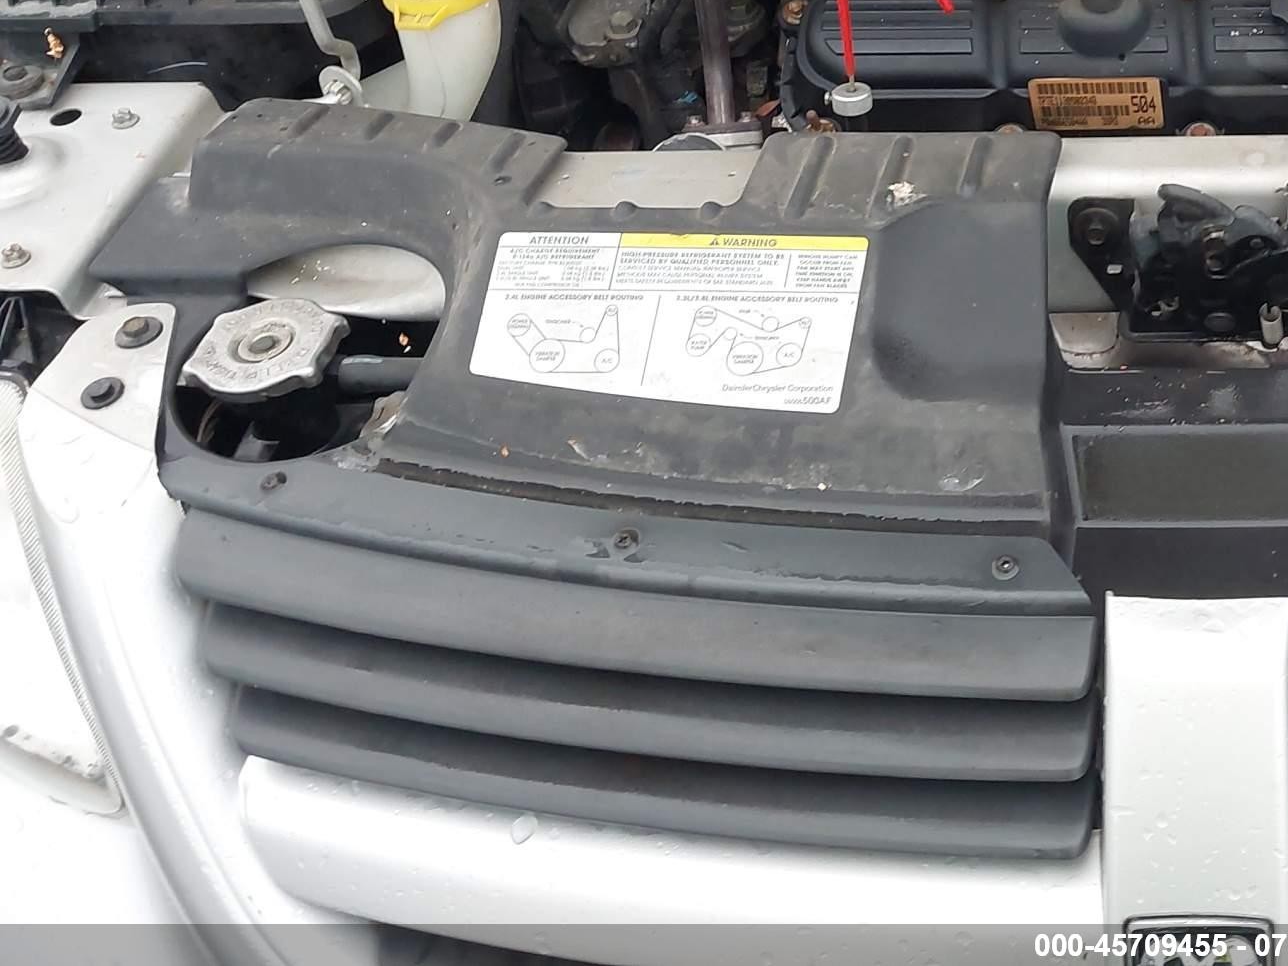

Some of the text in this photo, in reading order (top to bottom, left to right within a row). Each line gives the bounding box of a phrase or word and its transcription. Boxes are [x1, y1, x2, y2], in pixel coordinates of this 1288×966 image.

[529, 235, 590, 245] ATTENTION
[723, 238, 777, 247] WARNING
[722, 384, 834, 394] DaimlerChrysler Corporation
